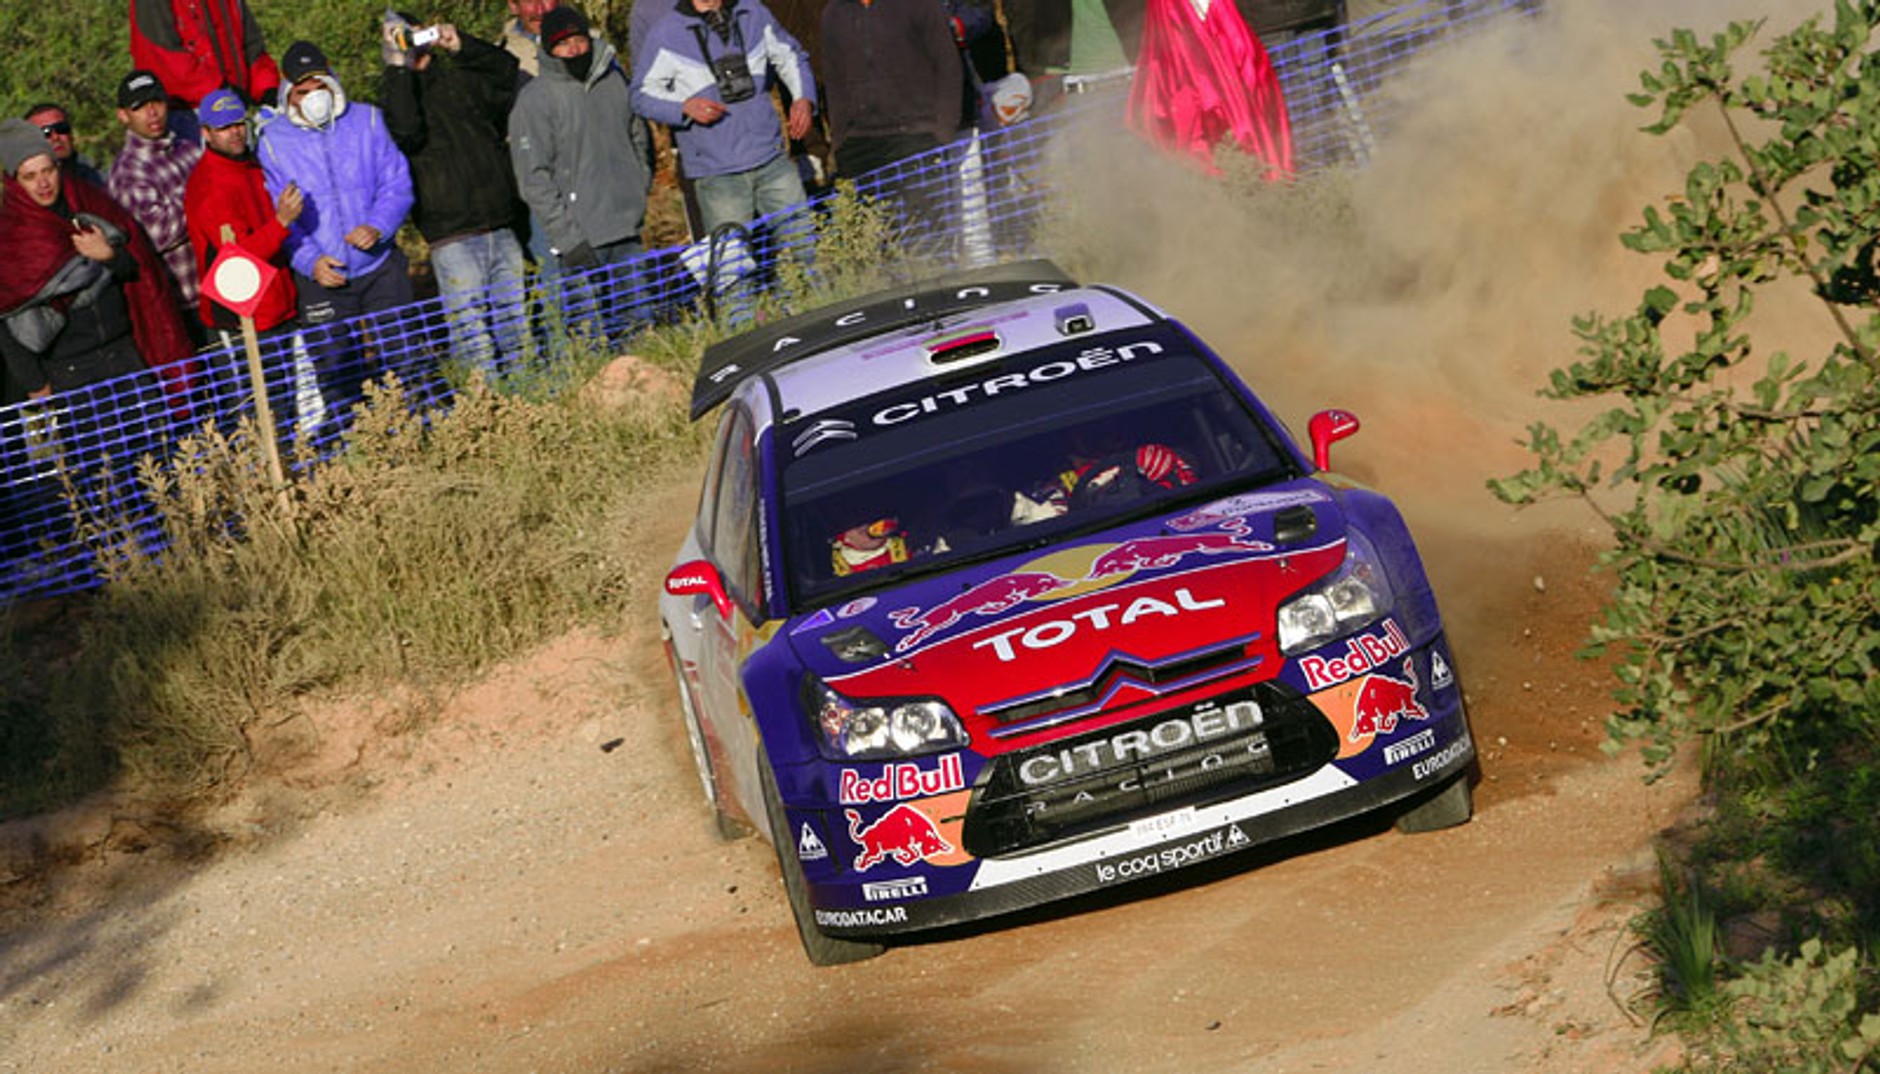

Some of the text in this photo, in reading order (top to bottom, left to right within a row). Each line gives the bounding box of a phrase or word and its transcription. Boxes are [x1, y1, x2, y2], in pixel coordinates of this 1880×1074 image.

[668, 575, 708, 590] TOTAL
[972, 587, 1226, 662] TOTAL
[1299, 618, 1411, 691] Red Bull
[839, 752, 966, 806] Red Bull
[1096, 830, 1226, 883] le coq sportif
[862, 876, 929, 902] PIRELLI
